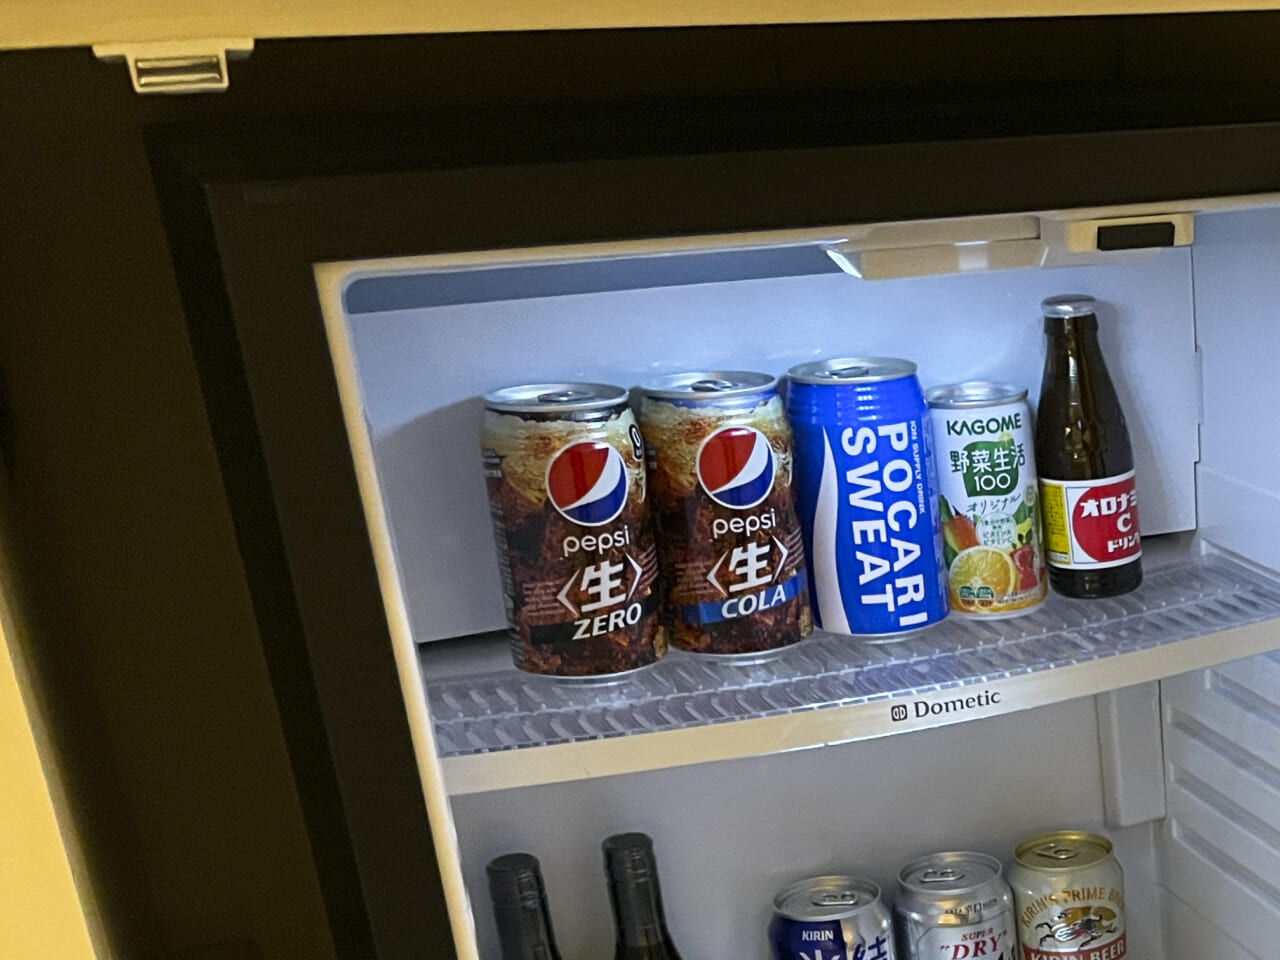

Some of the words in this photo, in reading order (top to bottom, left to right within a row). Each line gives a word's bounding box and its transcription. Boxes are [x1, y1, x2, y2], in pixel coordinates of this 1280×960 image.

[910, 420, 918, 440] ION
[946, 412, 1022, 436] KAGOME
[911, 443, 923, 480] SUPPLY
[950, 442, 1026, 474] 野菜生活
[974, 473, 1011, 492] 100
[841, 426, 895, 612] SWEAT
[966, 493, 1021, 516] オリジナル
[712, 508, 776, 539] pepsi
[877, 421, 928, 627] POCARI
[1116, 512, 1132, 533] C
[563, 525, 631, 557] pepsi
[722, 584, 787, 619] COLA
[572, 602, 642, 640] ZERO
[913, 690, 1001, 718] Dometic
[1019, 893, 1057, 929] KIRIN'S
[1062, 887, 1106, 904] PRIME
[801, 929, 834, 942] KIRIN
[961, 927, 994, 942] SUPER
